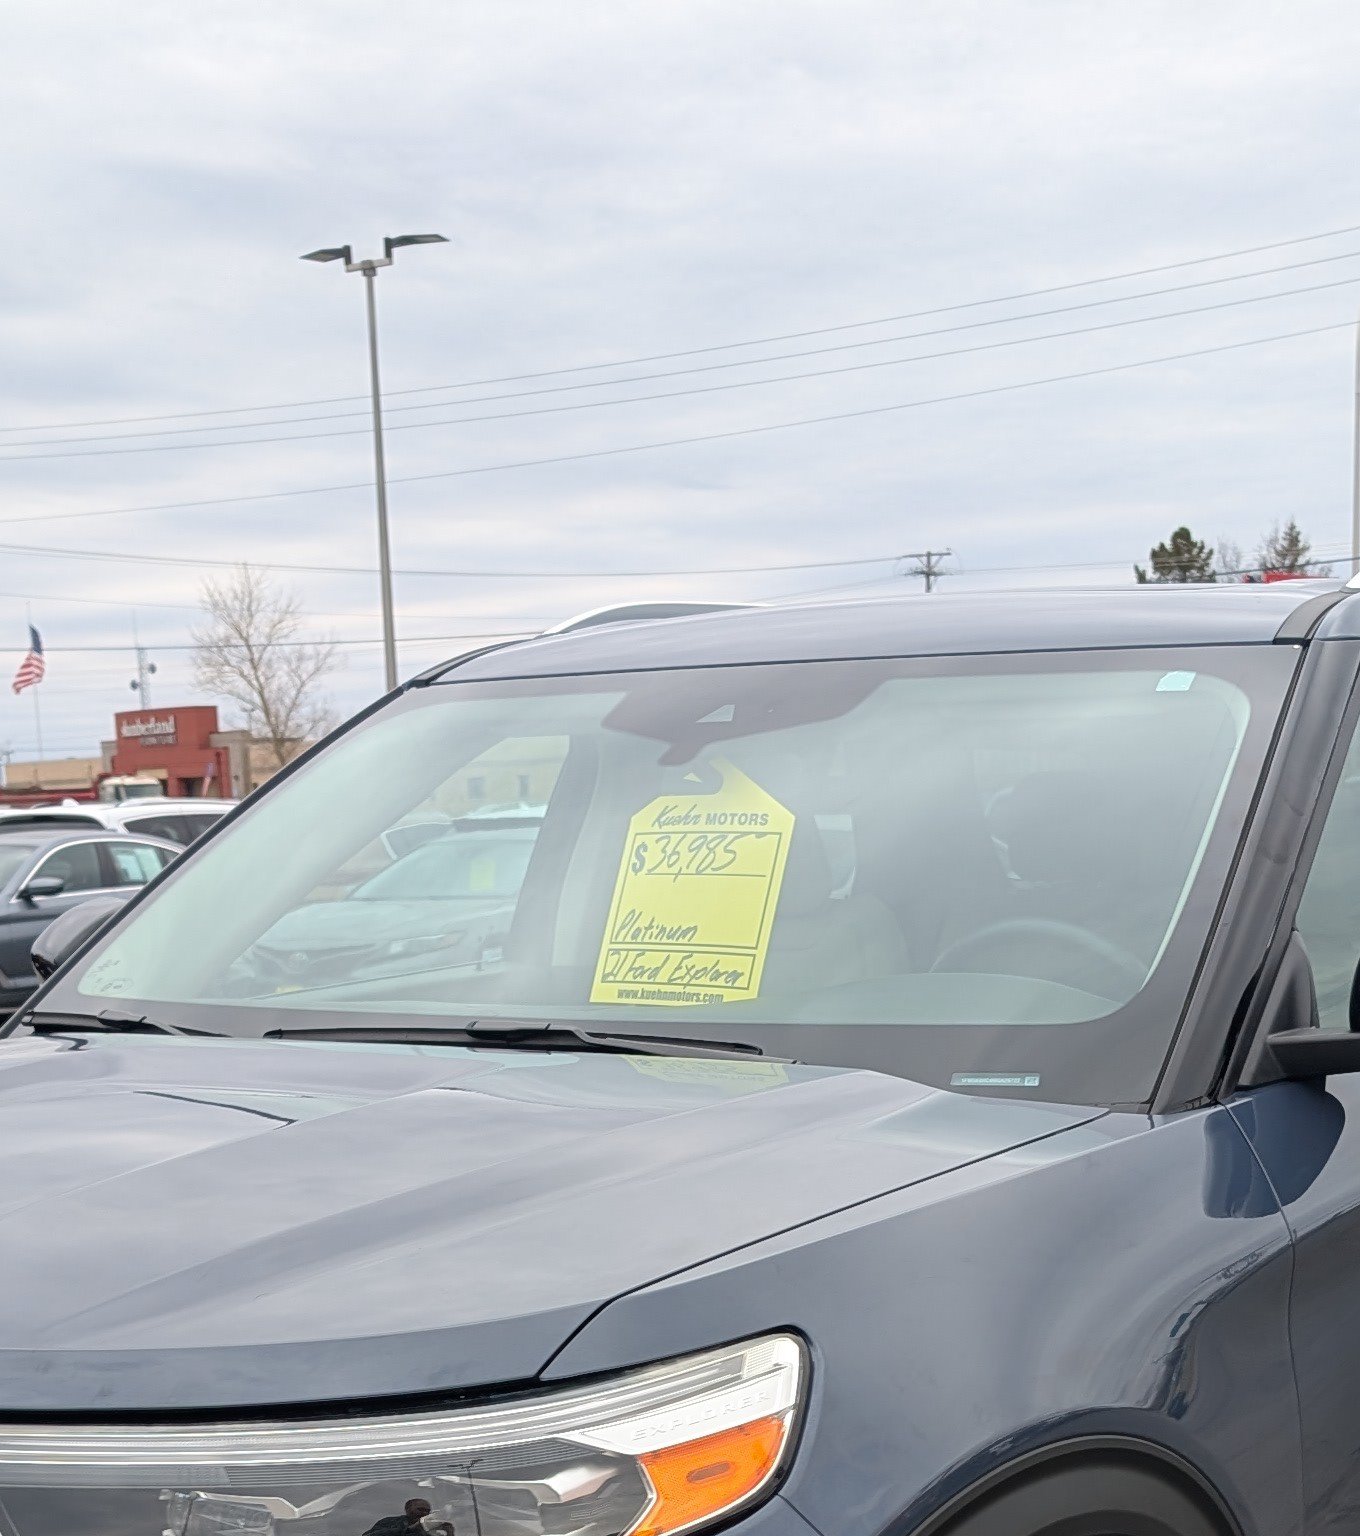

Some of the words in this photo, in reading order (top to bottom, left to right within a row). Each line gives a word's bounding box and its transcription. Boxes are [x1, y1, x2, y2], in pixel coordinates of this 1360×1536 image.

[705, 812, 770, 827] MOTORS
[614, 908, 698, 943] Platinum
[623, 951, 670, 982] Ford
[617, 987, 724, 1003] www.kuehnmotors.com
[632, 1391, 770, 1442] EXPLORER
